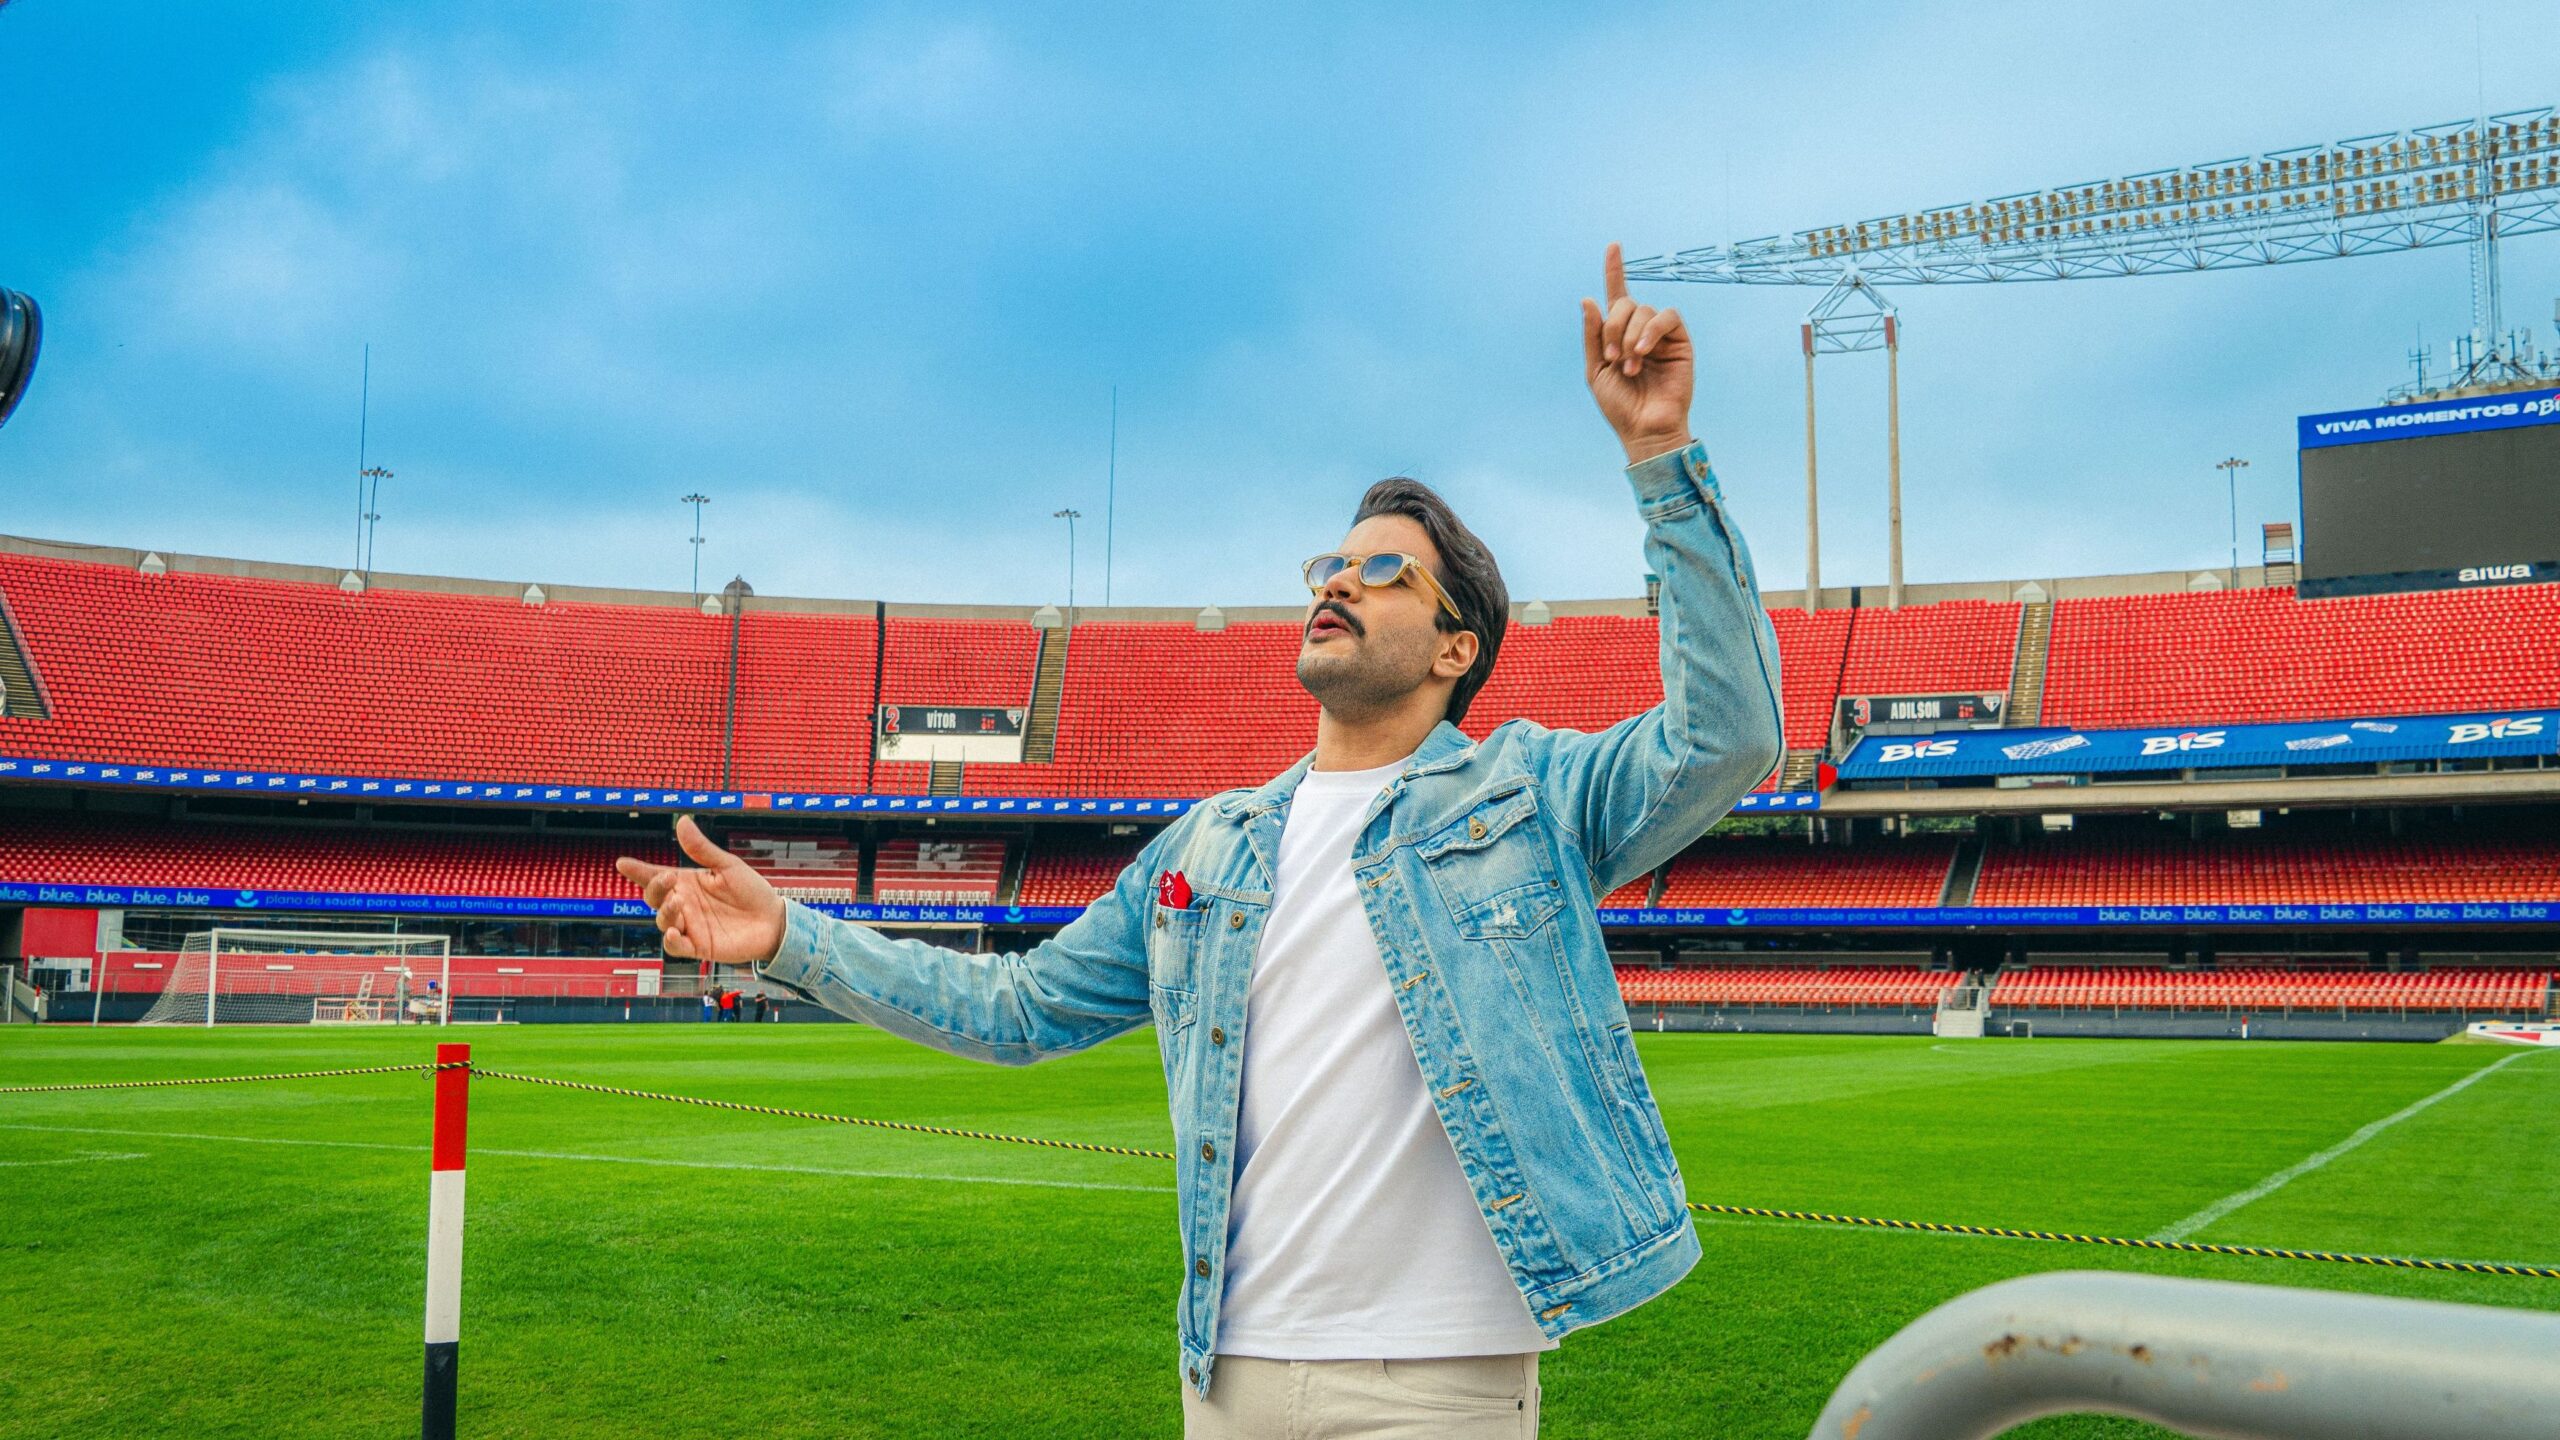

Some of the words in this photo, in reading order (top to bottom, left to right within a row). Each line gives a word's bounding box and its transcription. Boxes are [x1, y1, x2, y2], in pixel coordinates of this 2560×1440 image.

[2316, 418, 2371, 435] VIVA
[2376, 403, 2519, 428] MOMENTOS
[1854, 699, 1871, 726] 3
[1891, 701, 1940, 719] ADILSON
[886, 707, 900, 733] 2
[927, 710, 956, 729] VÍTOR
[39, 888, 74, 902] blue
[86, 889, 121, 903] blue
[133, 890, 167, 904] blue
[177, 891, 210, 905] blue
[266, 894, 302, 906] plano
[305, 894, 321, 905] de
[367, 898, 397, 910] para
[435, 898, 457, 908] sua
[507, 901, 514, 910] e
[517, 900, 538, 910] sua
[541, 901, 594, 912] empresa
[613, 902, 642, 914] blue
[843, 906, 872, 919] blue
[881, 907, 911, 919] blue
[919, 908, 948, 920] blue
[955, 908, 984, 920] blue
[2099, 909, 2132, 921] blue
[2140, 908, 2173, 920] blue
[2184, 907, 2218, 920] blue
[2229, 907, 2263, 920] blue
[2274, 907, 2308, 920] blue
[2320, 906, 2355, 919] blue
[2368, 906, 2402, 919] blue
[2414, 905, 2450, 919] blue
[2462, 905, 2499, 918] blue
[2510, 905, 2547, 918] blue
[1600, 911, 1629, 923] blue
[1638, 911, 1668, 923] blue
[1675, 911, 1705, 923] blue
[1754, 912, 1788, 923] plano
[1790, 912, 1806, 921] de
[1847, 913, 1877, 923] para
[1914, 913, 1936, 921] sua
[1985, 912, 1994, 920] e
[1996, 912, 2019, 921] sua
[2022, 912, 2078, 923] empresa
